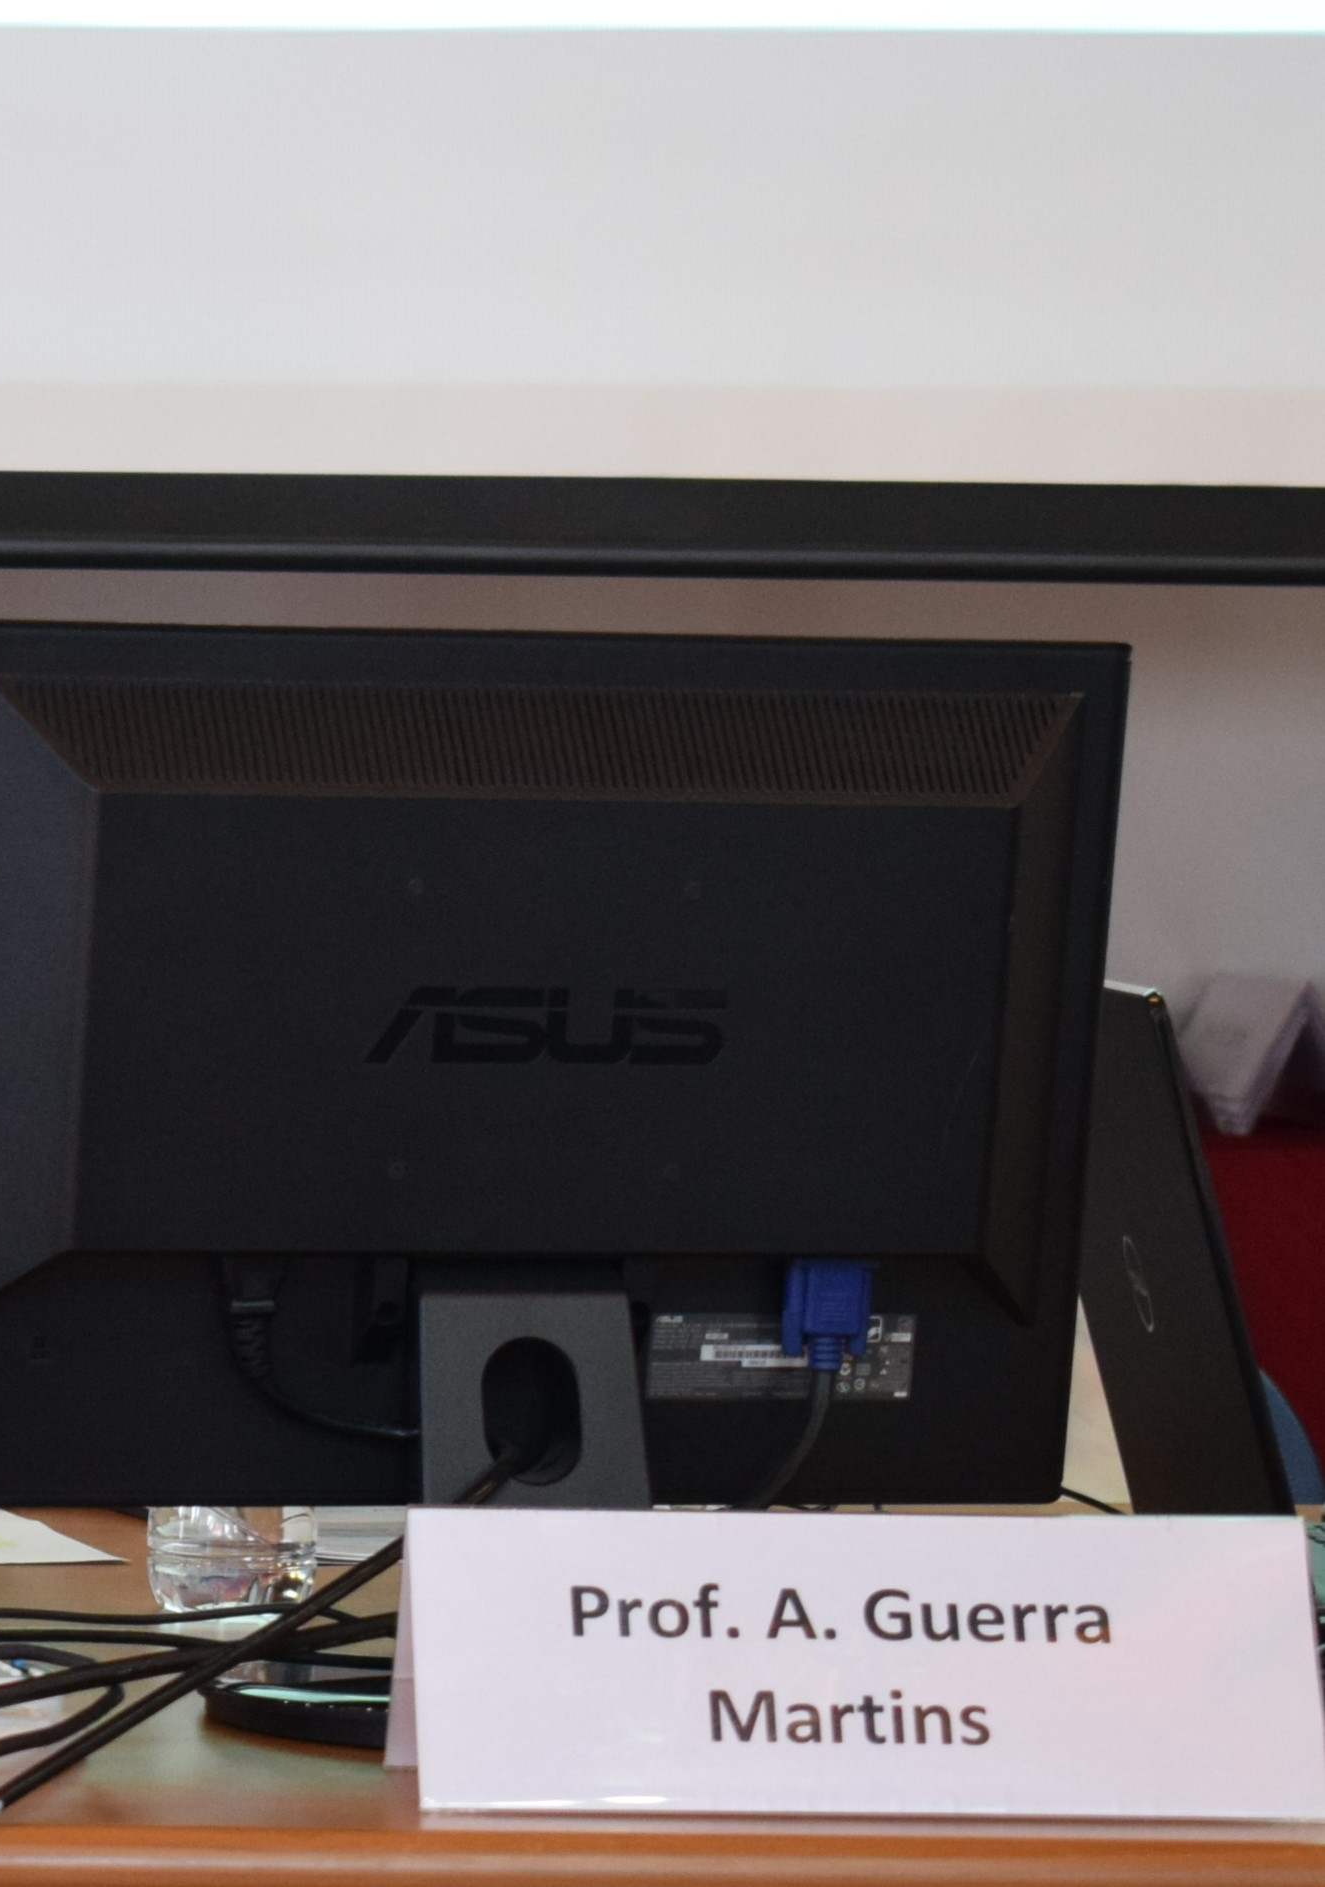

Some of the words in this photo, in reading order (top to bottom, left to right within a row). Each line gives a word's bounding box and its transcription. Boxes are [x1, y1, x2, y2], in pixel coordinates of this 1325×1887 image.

[362, 986, 728, 1065] ASUS
[571, 1584, 740, 1639] Prof.
[767, 1588, 837, 1640] A.
[864, 1588, 1111, 1644] Guerra
[709, 1690, 990, 1746] Martins
